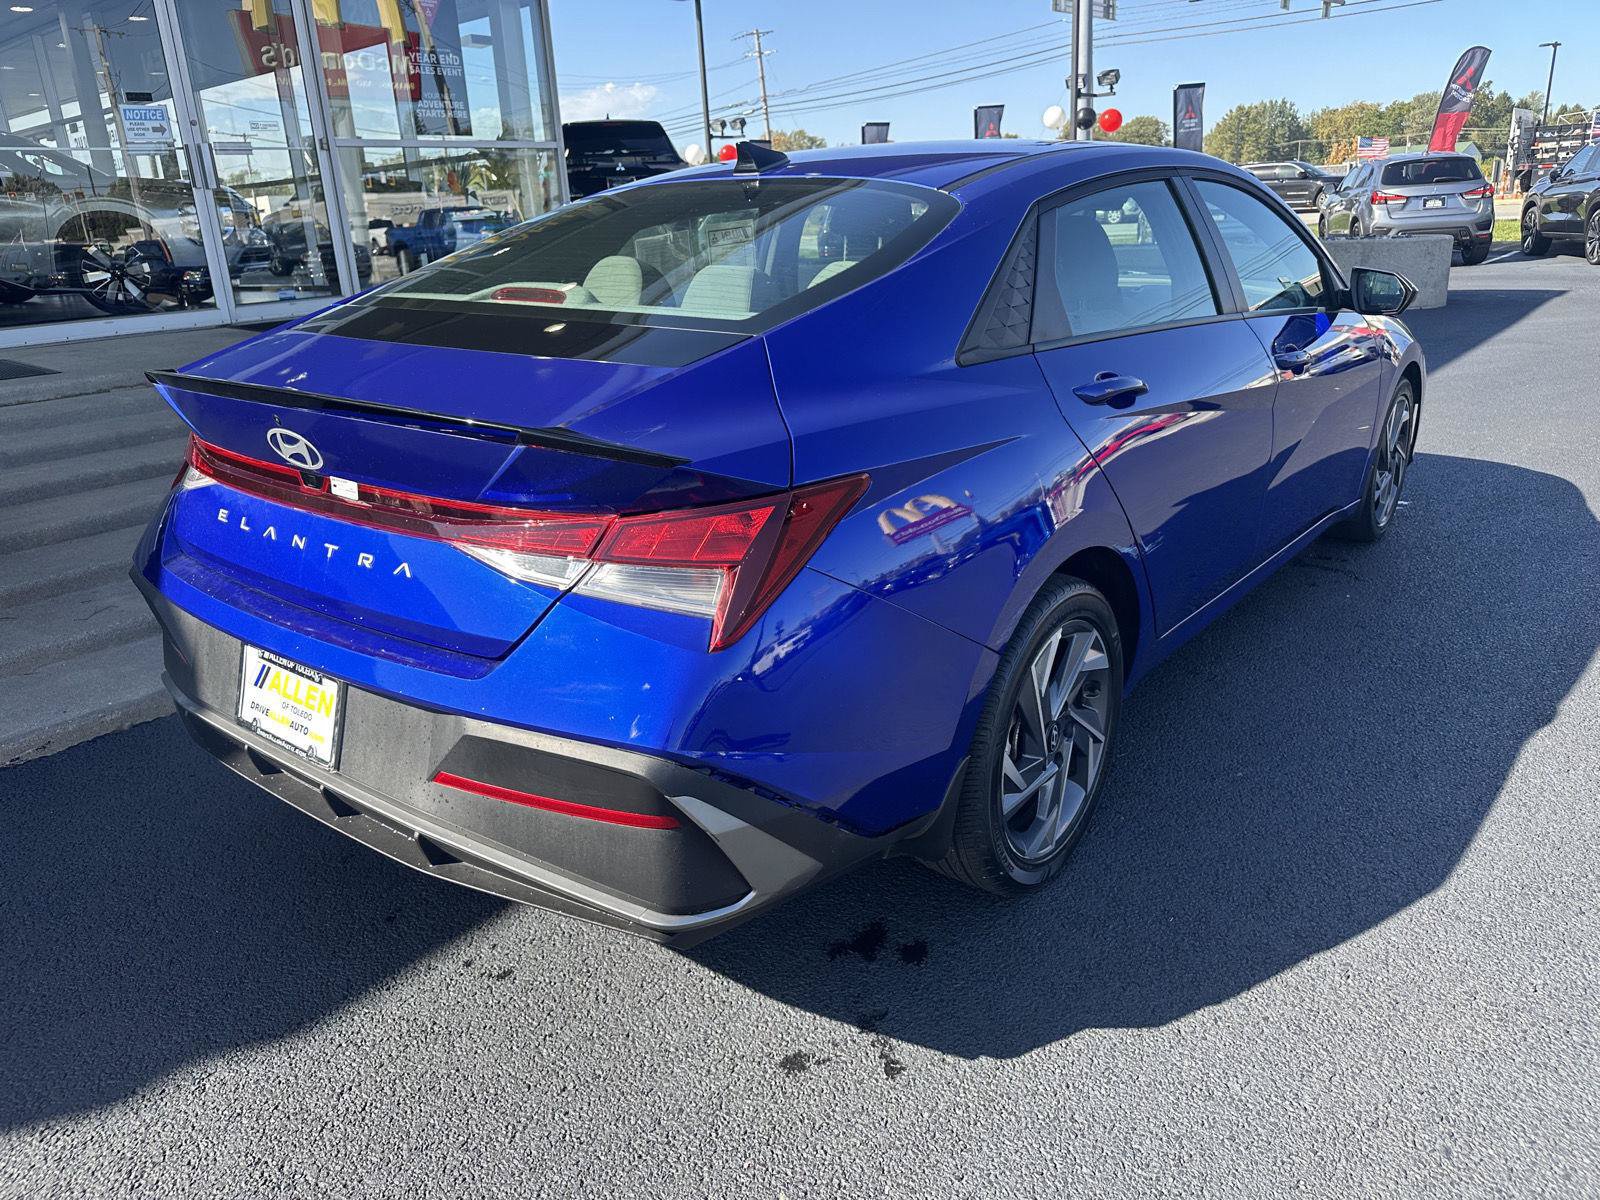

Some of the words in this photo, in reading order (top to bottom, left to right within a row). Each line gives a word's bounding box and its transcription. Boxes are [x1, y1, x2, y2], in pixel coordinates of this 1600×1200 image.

[409, 52, 437, 64] YEAR
[440, 54, 459, 65] END
[409, 65, 435, 75] SALES
[437, 67, 463, 77] EVENT
[417, 100, 465, 110] ADVENTURE
[125, 109, 163, 120] NOTICE
[416, 109, 446, 118] STARTS
[446, 110, 468, 119] HERE
[217, 508, 412, 579] ELANTRA
[267, 671, 335, 718] ALLEN
[281, 701, 290, 710] OF
[290, 705, 313, 722] TOLEDO
